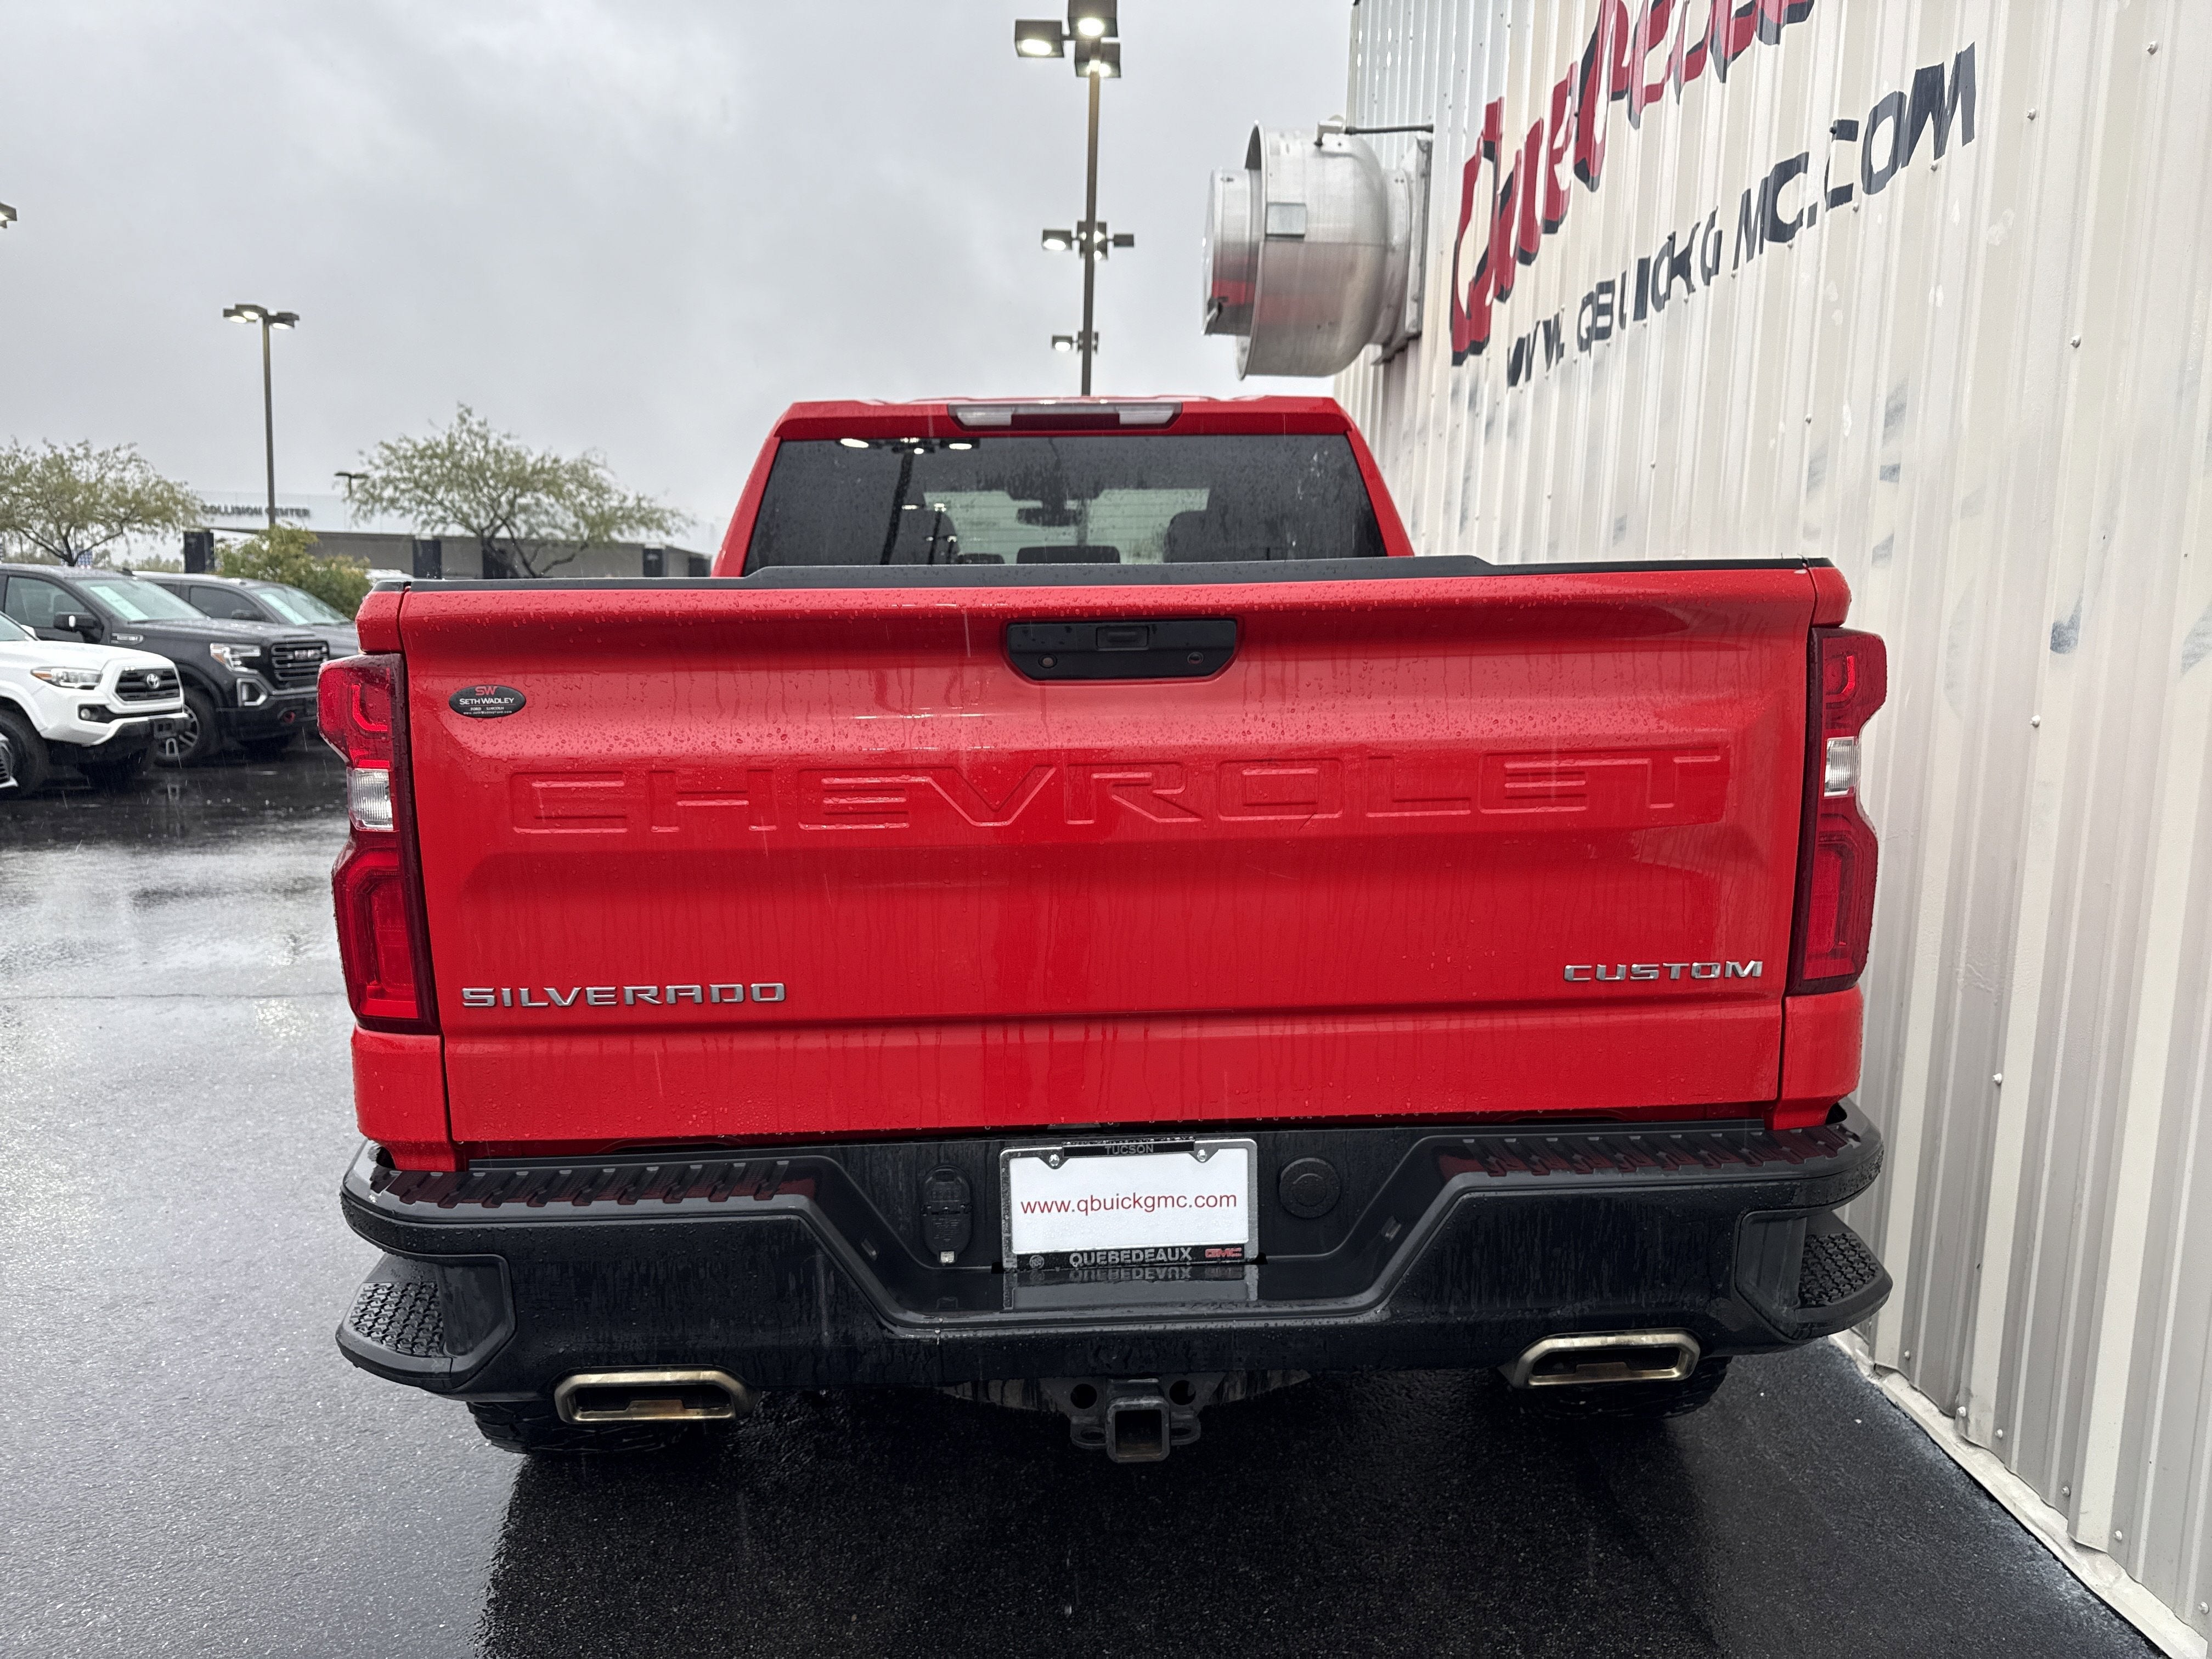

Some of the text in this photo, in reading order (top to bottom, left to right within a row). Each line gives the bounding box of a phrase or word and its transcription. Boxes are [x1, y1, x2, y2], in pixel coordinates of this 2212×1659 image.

[475, 686, 498, 696] SW
[512, 745, 1722, 834] CHEVROLET
[1564, 961, 1763, 982] CUSTOM
[461, 983, 787, 1007] SILVERADO
[1104, 1144, 1154, 1155] TUCSON
[1020, 1192, 1237, 1216] www.qbuickgmc.com
[1069, 1247, 1243, 1266] QUEBEDEAUX GMC
